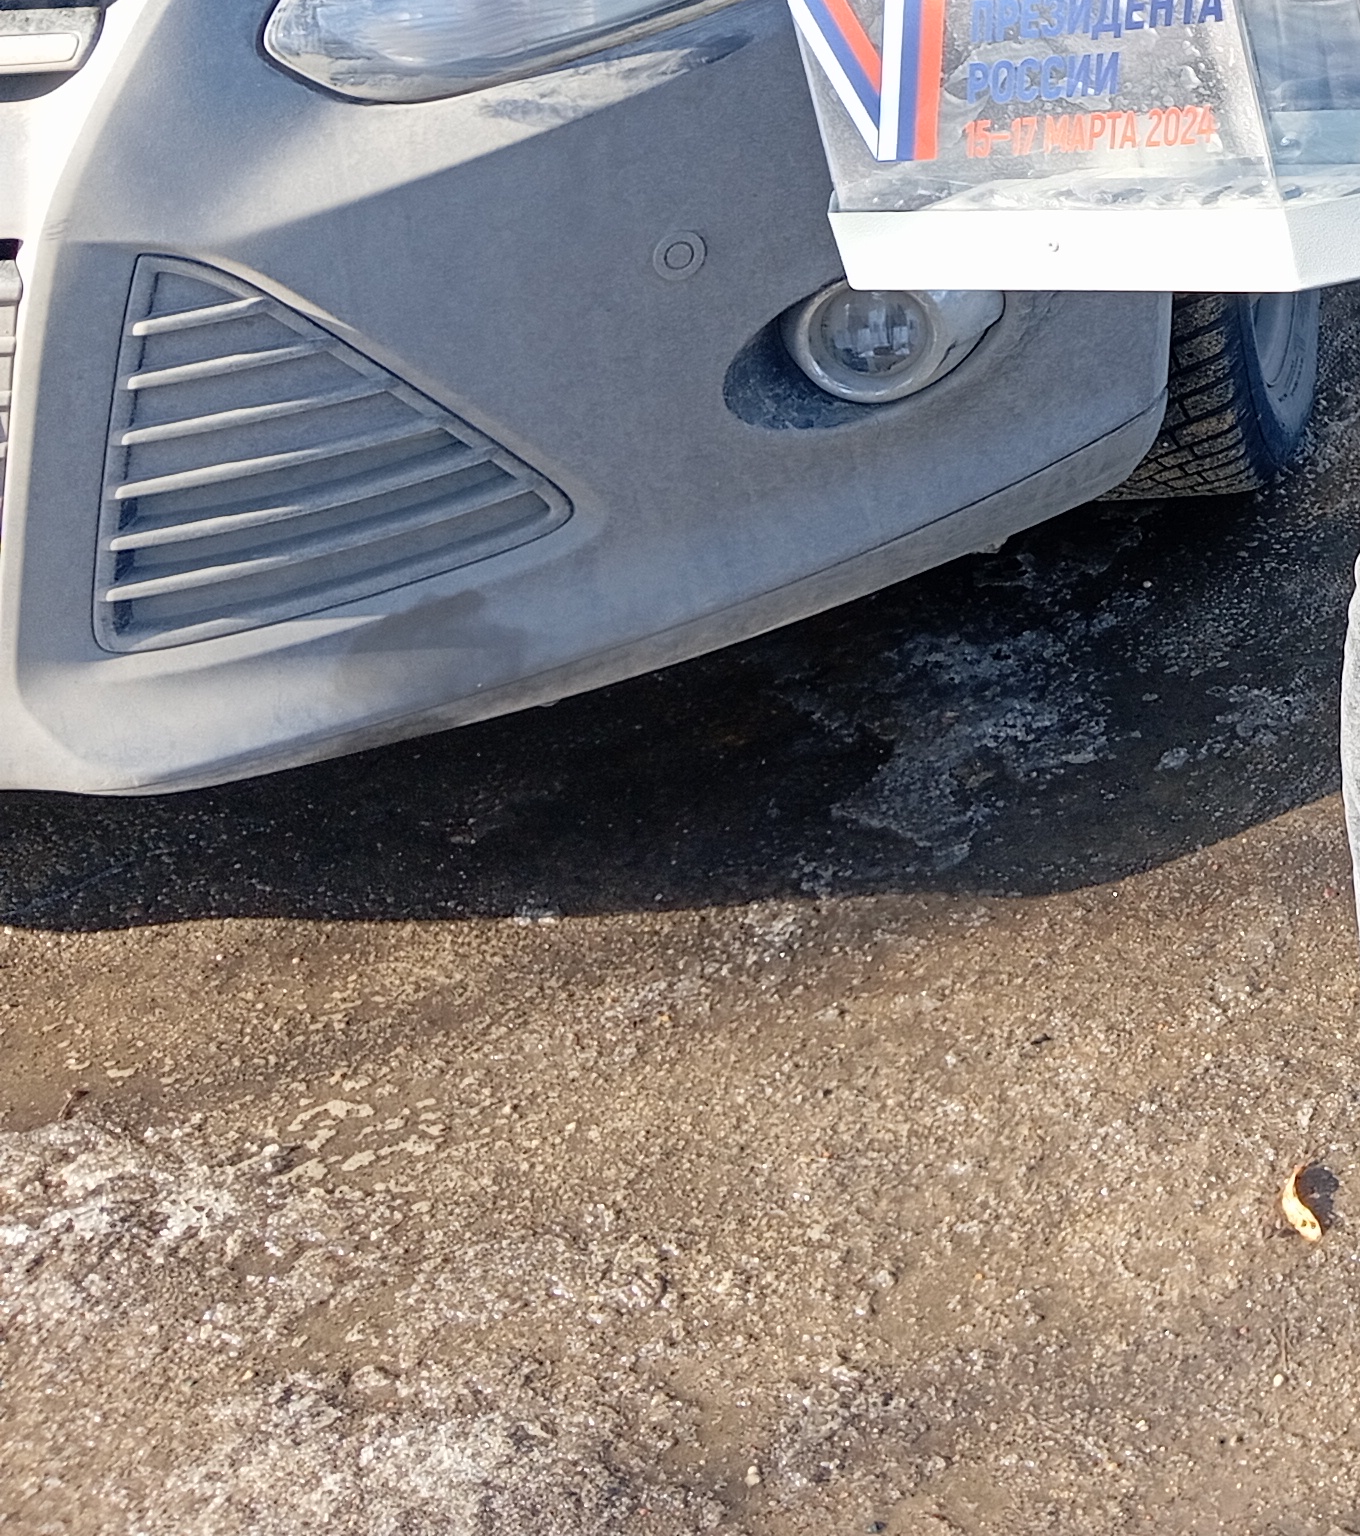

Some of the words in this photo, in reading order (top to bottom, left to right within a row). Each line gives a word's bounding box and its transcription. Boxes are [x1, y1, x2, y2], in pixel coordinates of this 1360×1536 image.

[966, 51, 1121, 105] РОССИИ
[1043, 110, 1141, 154] МАРТА
[1144, 103, 1219, 149] 2024
